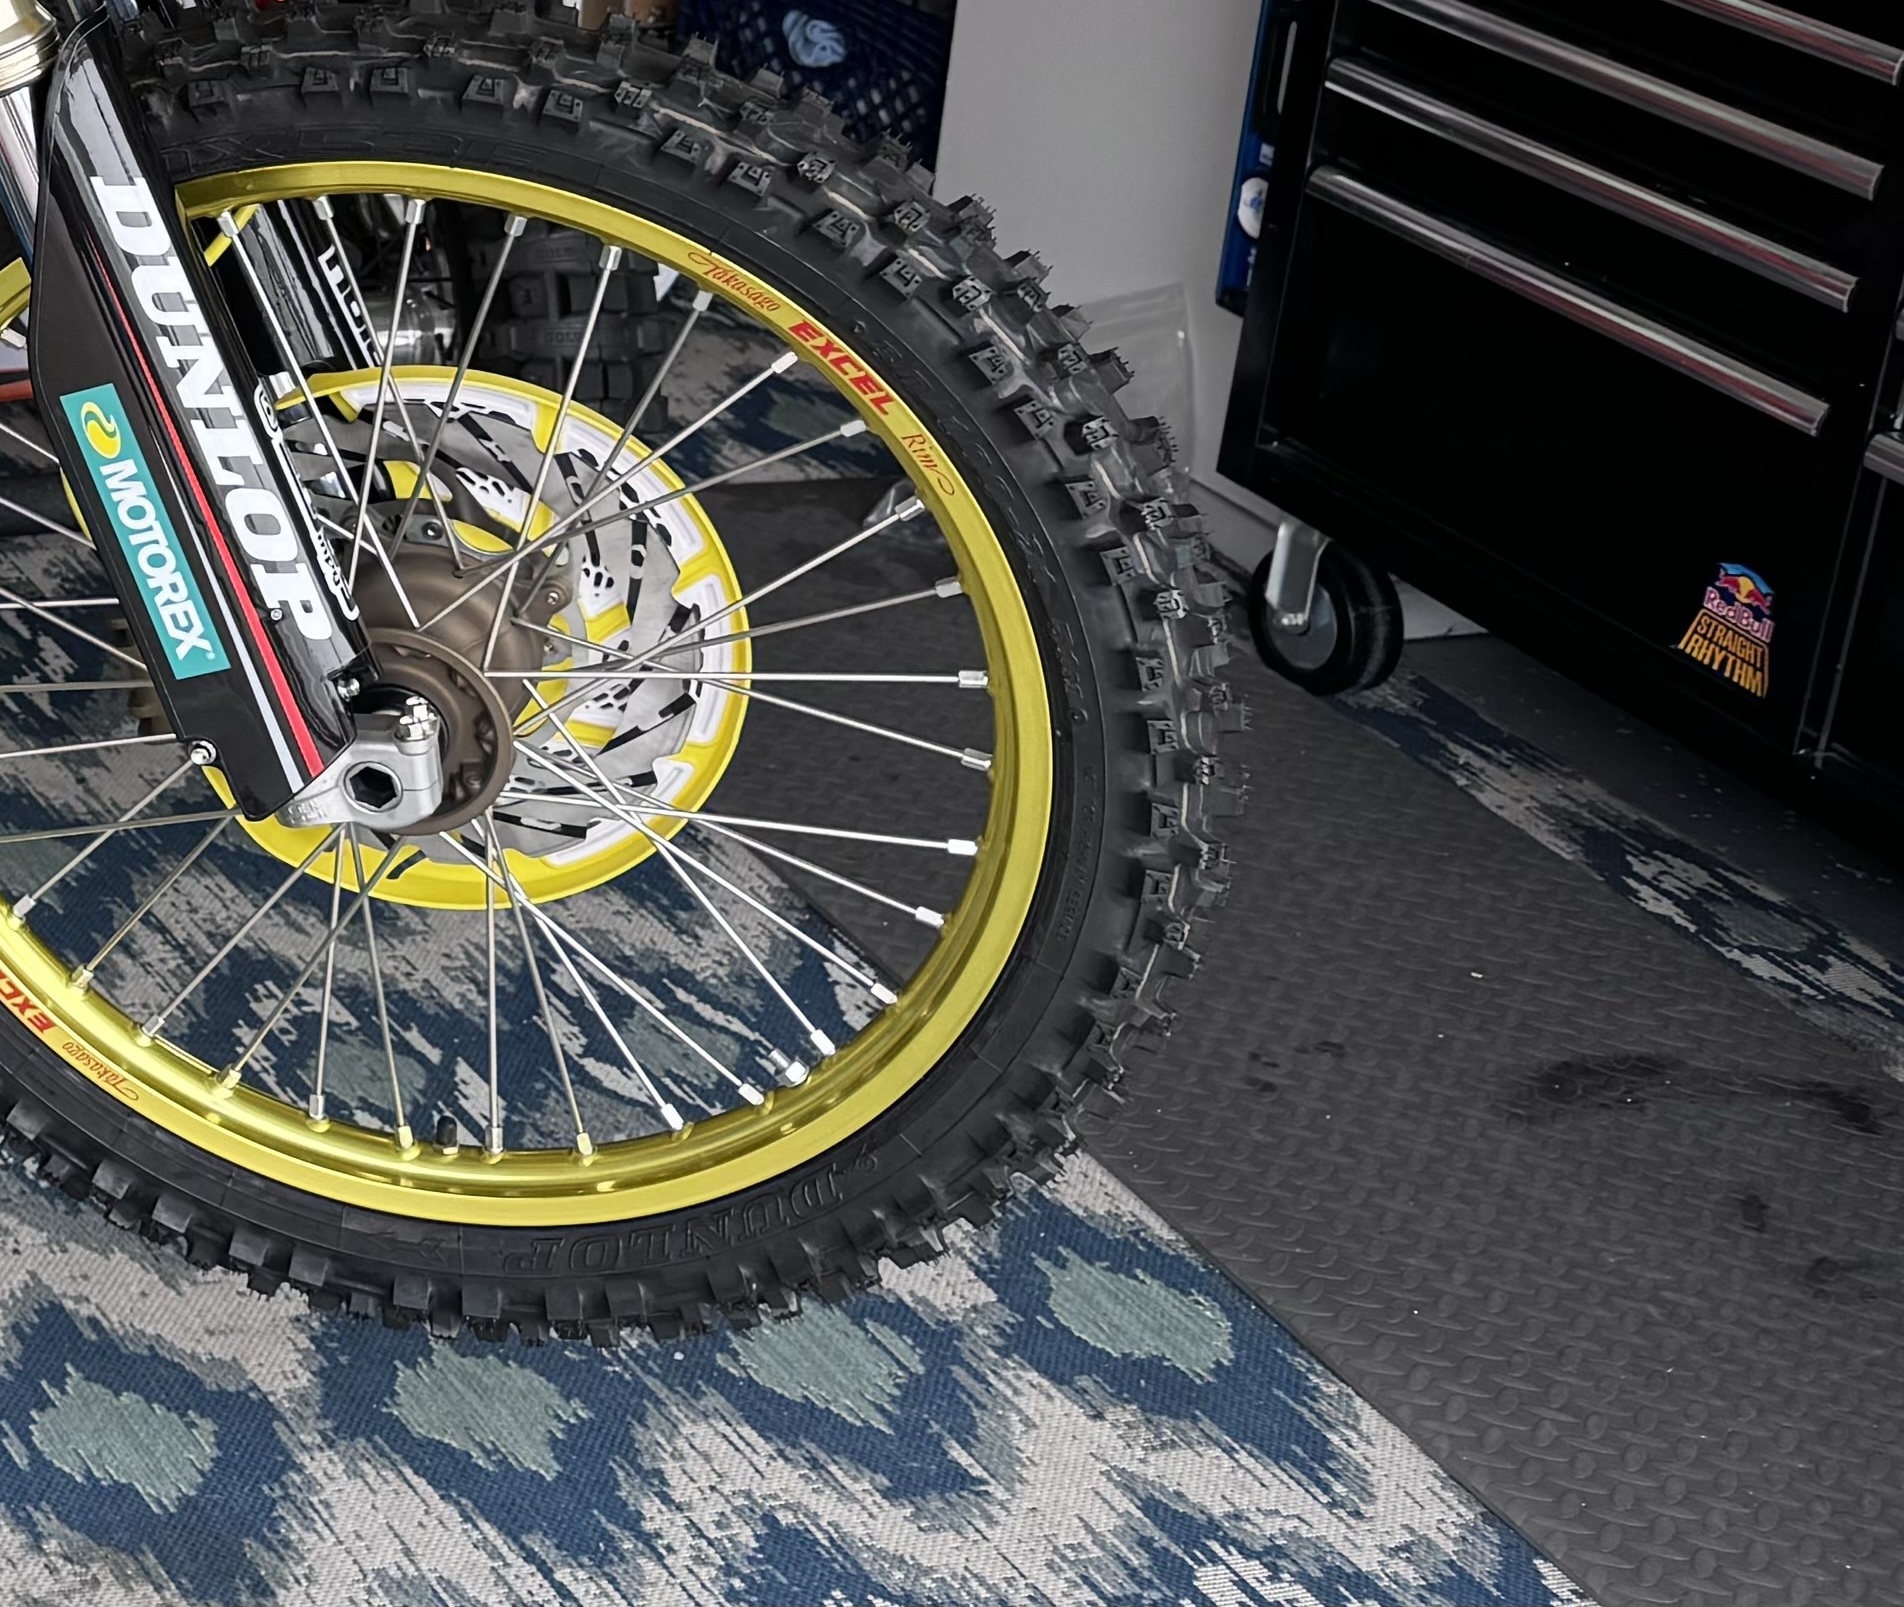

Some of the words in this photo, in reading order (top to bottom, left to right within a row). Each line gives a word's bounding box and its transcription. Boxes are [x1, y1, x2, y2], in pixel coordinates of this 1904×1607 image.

[688, 251, 780, 312] Takasago
[789, 319, 896, 416] EXCEL
[90, 177, 333, 641] DUNLOP
[901, 433, 955, 495] Rim
[99, 458, 214, 661] MOTOREX
[1684, 633, 1763, 698] RHYTHM
[1697, 614, 1764, 669] STRAIGHT
[61, 1041, 140, 1101] Takasago
